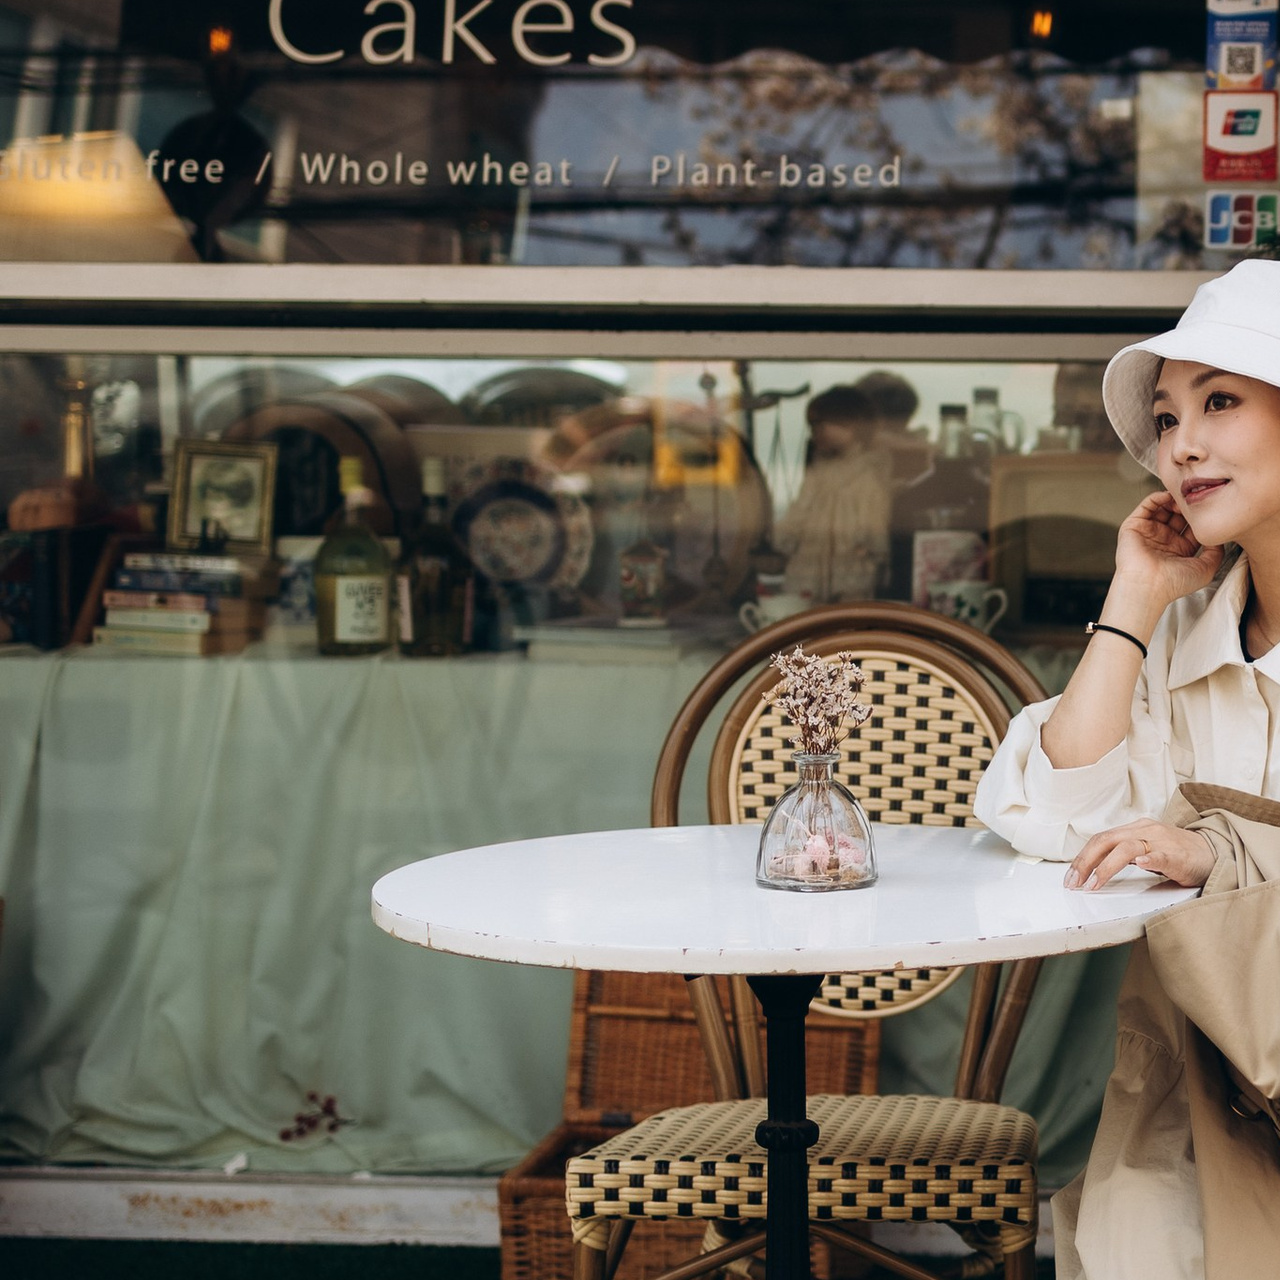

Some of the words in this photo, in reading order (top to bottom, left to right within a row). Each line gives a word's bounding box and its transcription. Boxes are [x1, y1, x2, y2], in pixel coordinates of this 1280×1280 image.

[145, 149, 225, 183] free
[300, 151, 428, 184] Whole
[446, 152, 573, 185] wheat
[651, 154, 902, 187] Plant-based
[1209, 210, 1274, 229] JCB
